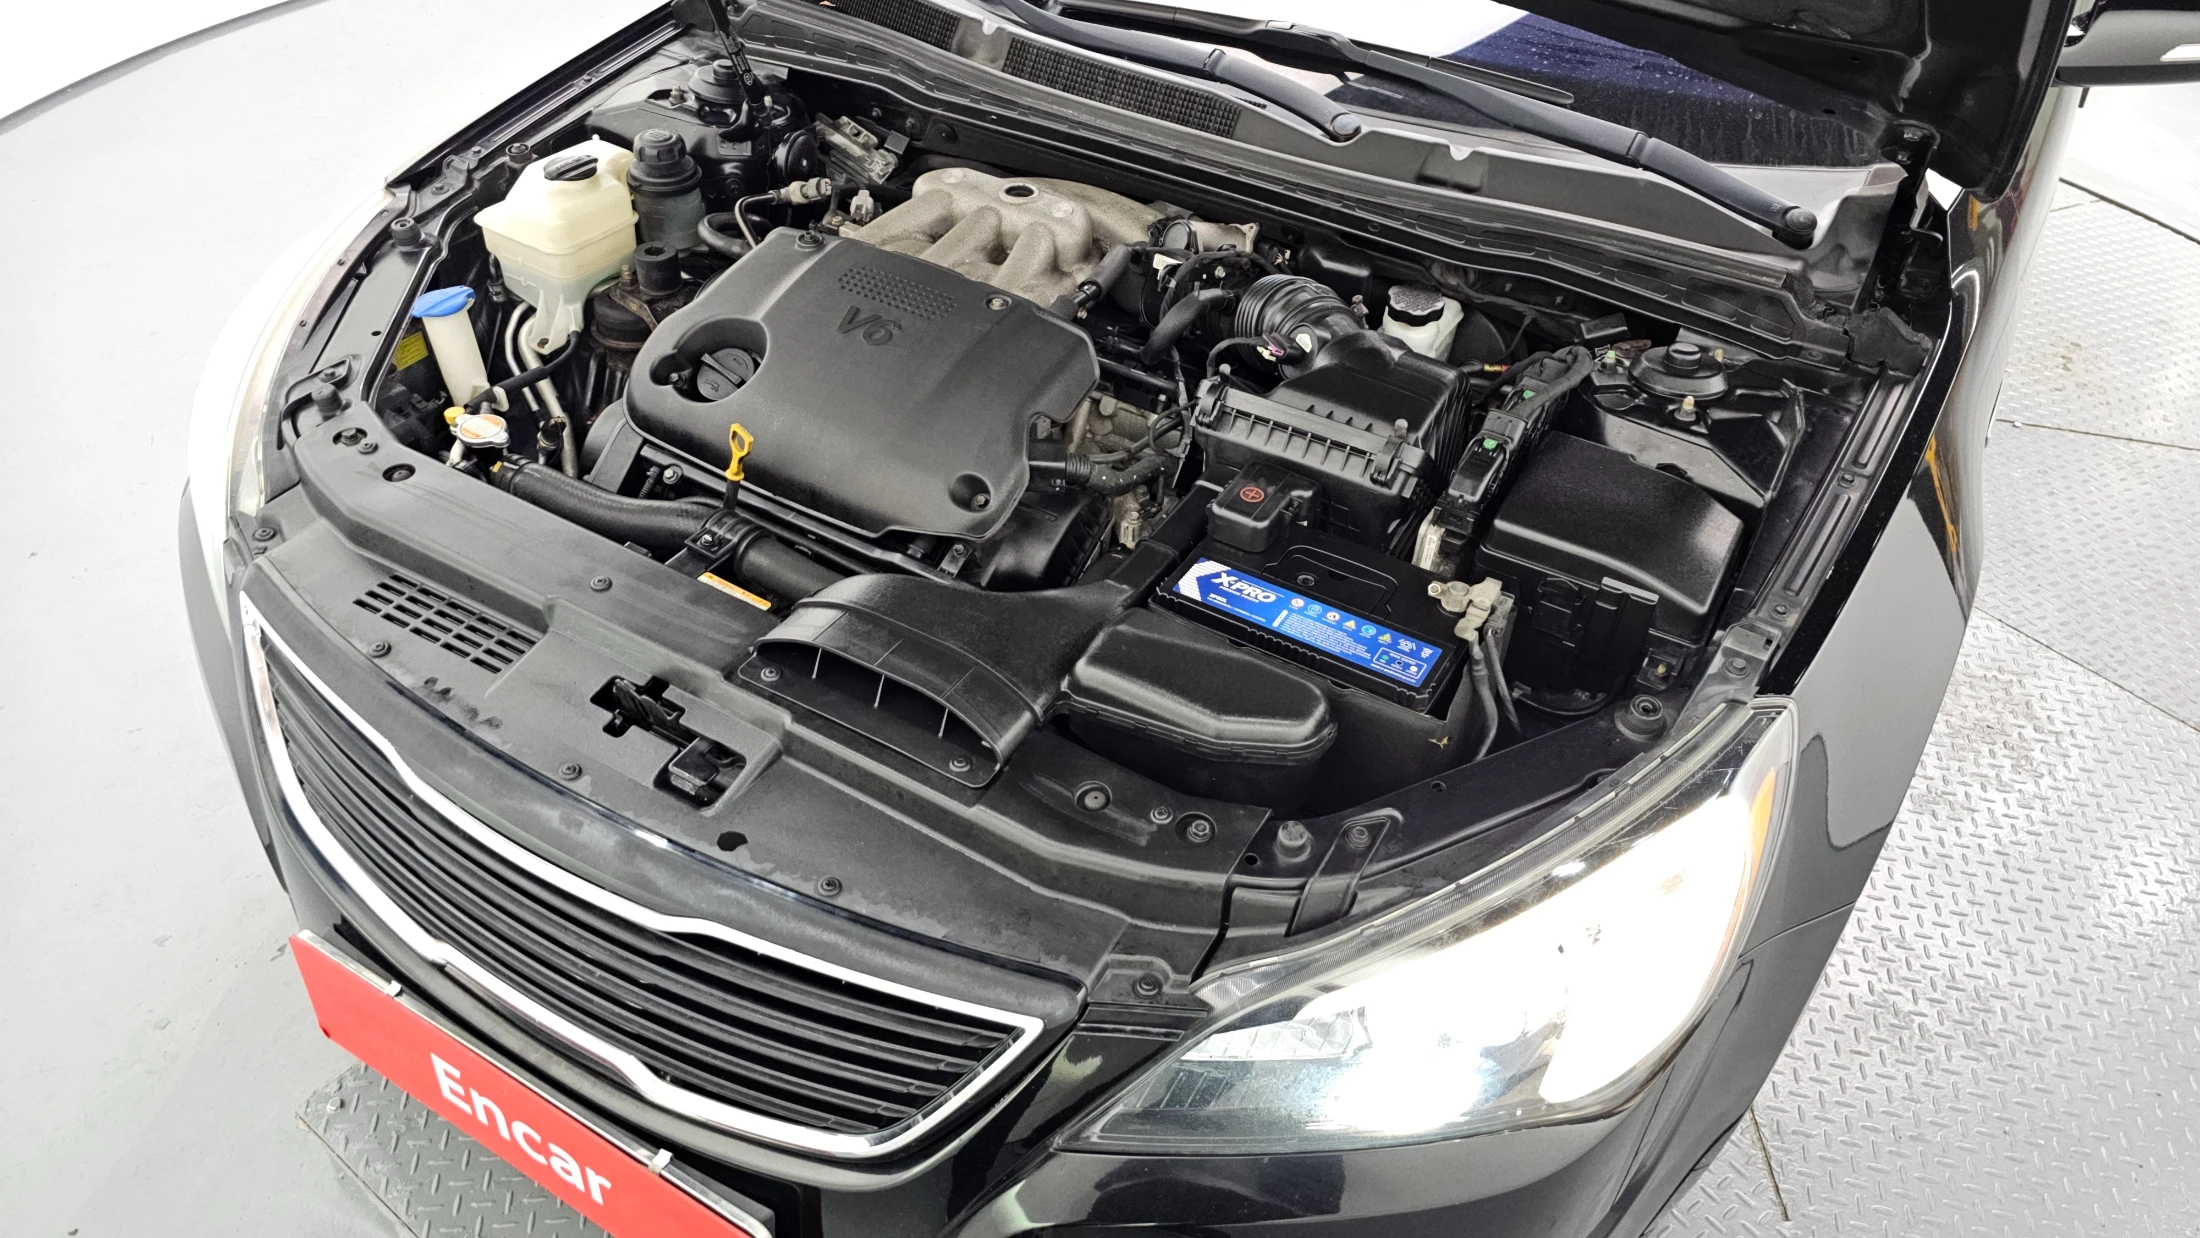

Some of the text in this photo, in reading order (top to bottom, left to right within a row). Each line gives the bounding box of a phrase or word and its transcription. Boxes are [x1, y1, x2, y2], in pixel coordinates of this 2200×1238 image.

[837, 305, 903, 346] V6
[1210, 572, 1277, 603] X-PRO
[430, 1052, 612, 1205] Encar
